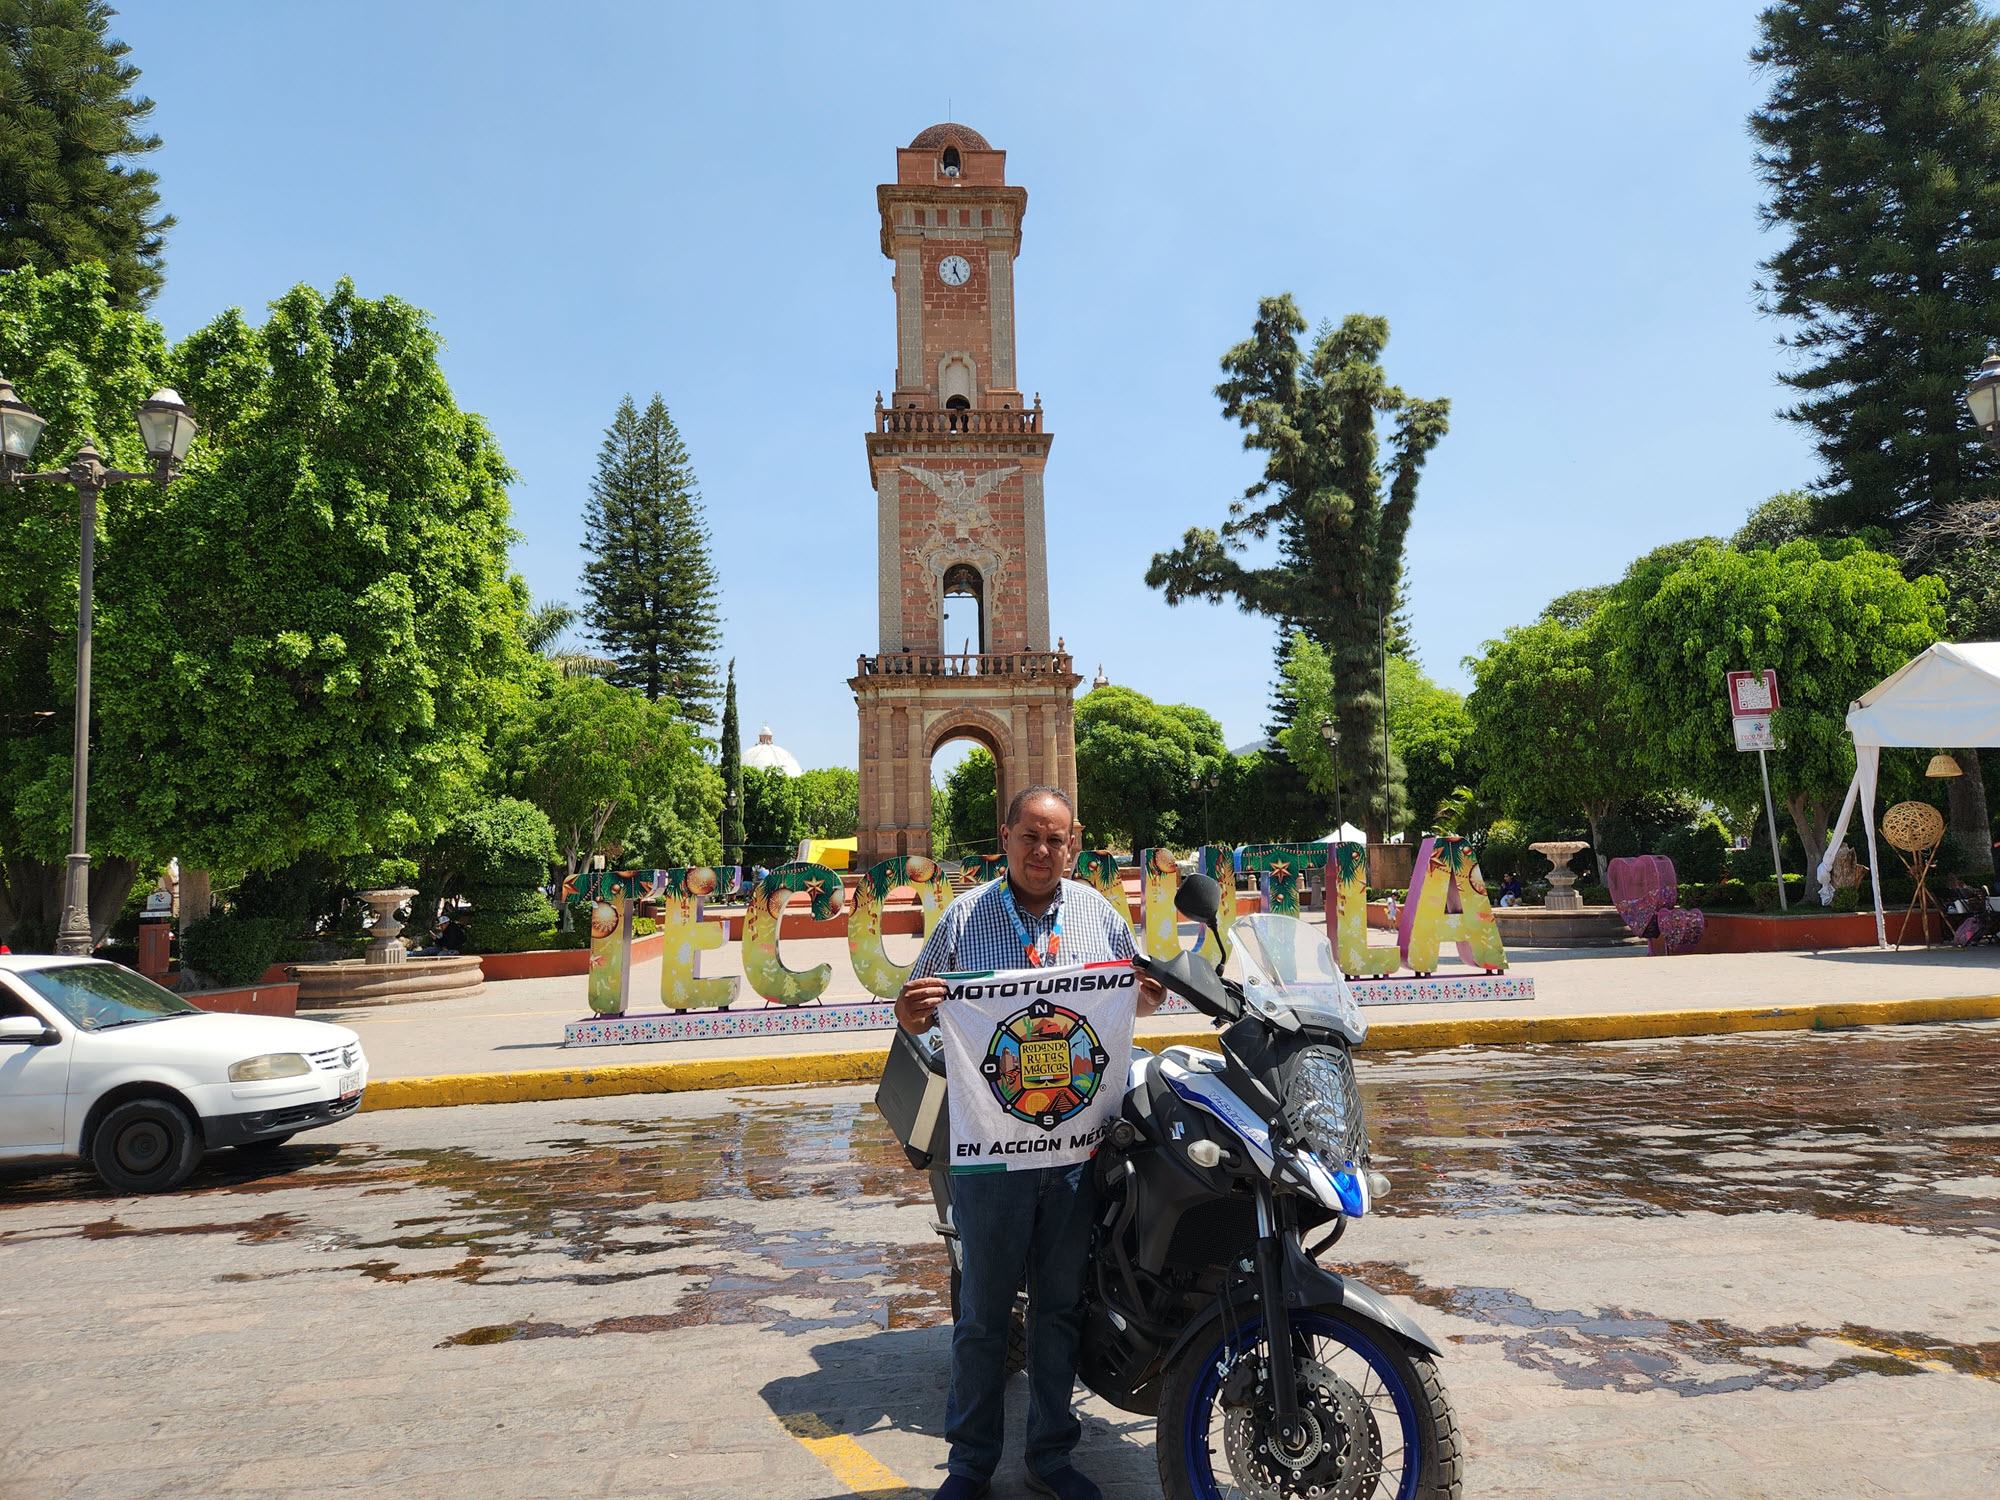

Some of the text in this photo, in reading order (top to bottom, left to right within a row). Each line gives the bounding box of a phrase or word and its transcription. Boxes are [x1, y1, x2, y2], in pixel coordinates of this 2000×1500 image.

[1003, 894, 1026, 936] SUZUKI
[943, 973, 1135, 1001] MOTOTURISMO
[1035, 1004, 1048, 1014] N
[1095, 1055, 1105, 1065] E
[1043, 1115, 1054, 1125] S
[956, 1143, 981, 1156] EN
[988, 1134, 1061, 1155] ACCIÓN
